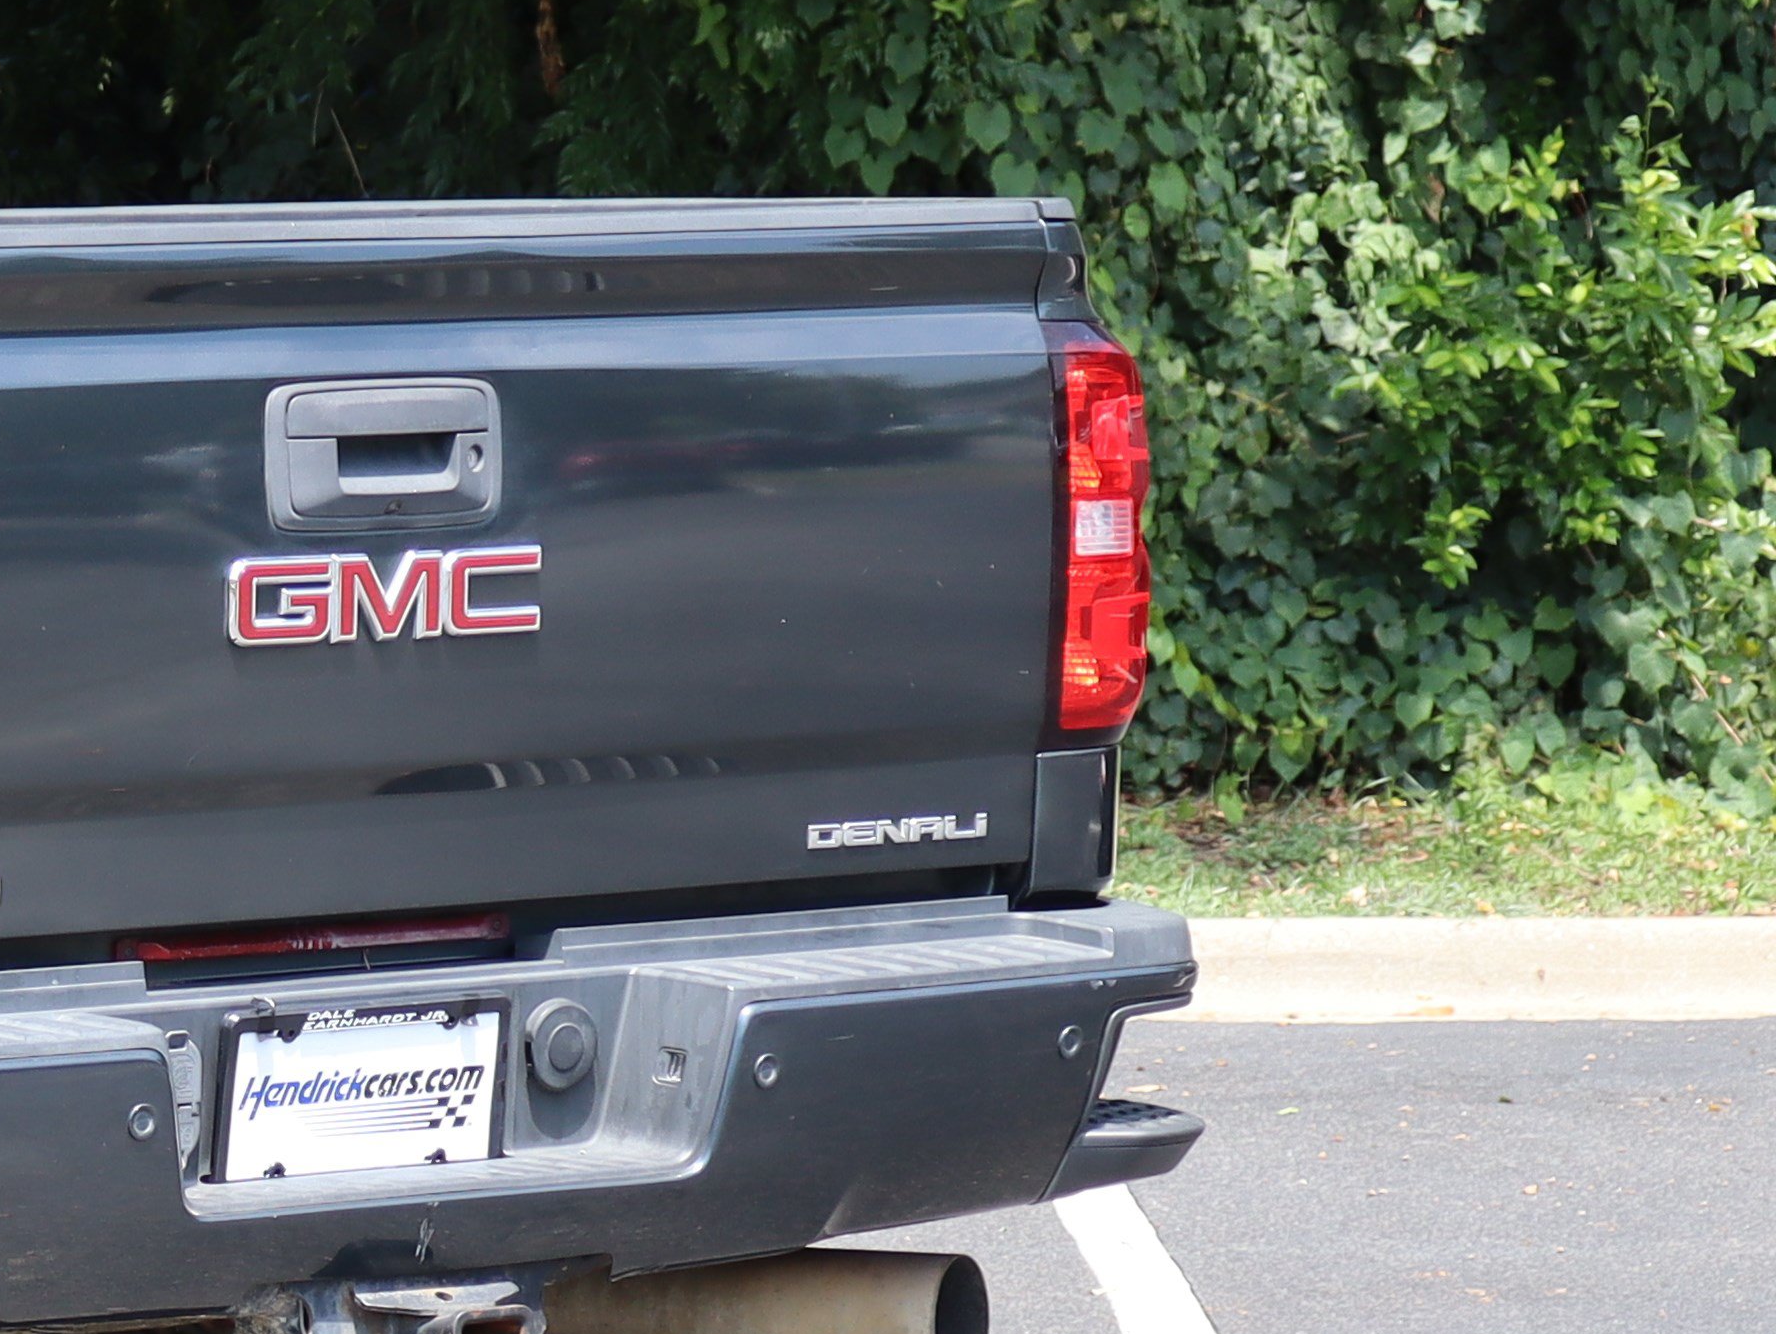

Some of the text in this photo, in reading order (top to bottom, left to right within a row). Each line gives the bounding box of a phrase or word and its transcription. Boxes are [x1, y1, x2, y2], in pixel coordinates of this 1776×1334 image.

[225, 544, 542, 647] GMC
[806, 812, 989, 851] DENALI
[302, 1012, 418, 1031] EARNHARDT
[307, 1009, 357, 1022] DALE
[238, 1065, 486, 1121] Hendrickcars.com
